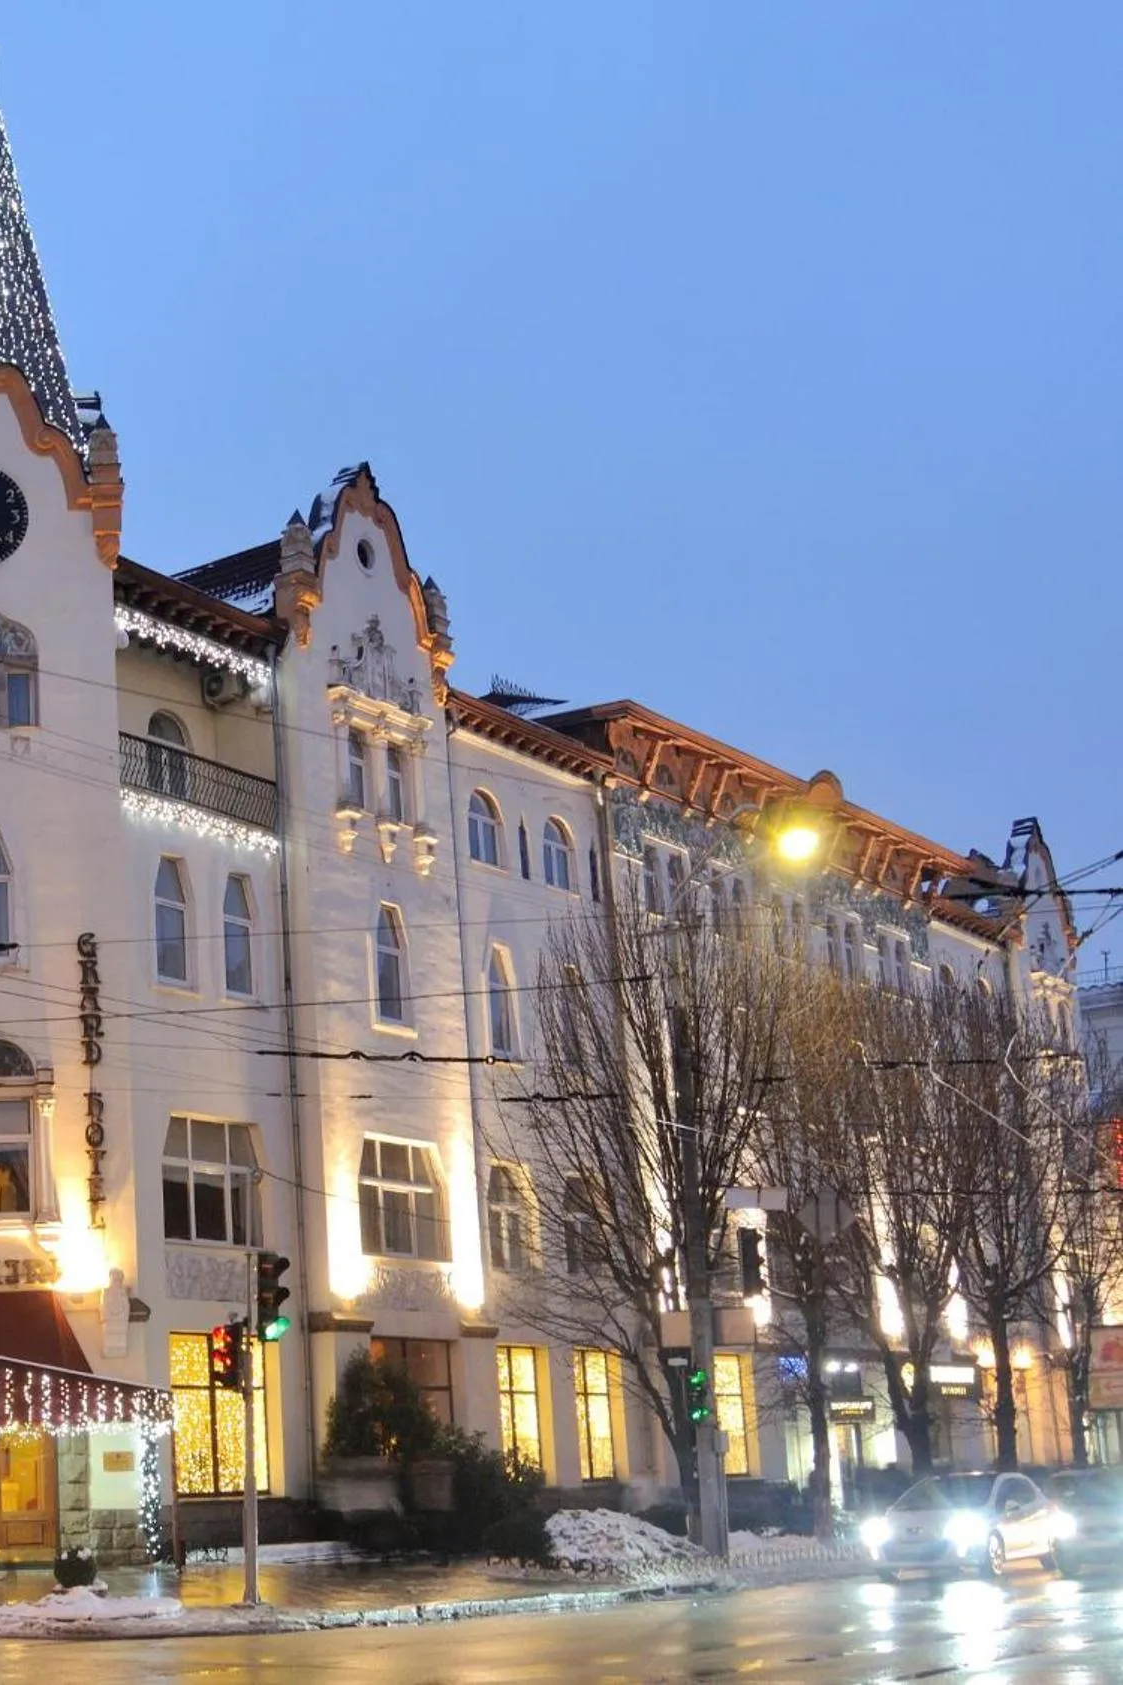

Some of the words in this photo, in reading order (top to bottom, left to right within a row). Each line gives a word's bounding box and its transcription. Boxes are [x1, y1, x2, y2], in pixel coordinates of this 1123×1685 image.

[6, 489, 15, 503] 2
[10, 509, 20, 524] 3
[5, 530, 14, 543] 4
[83, 1092, 106, 1229] HOTEL
